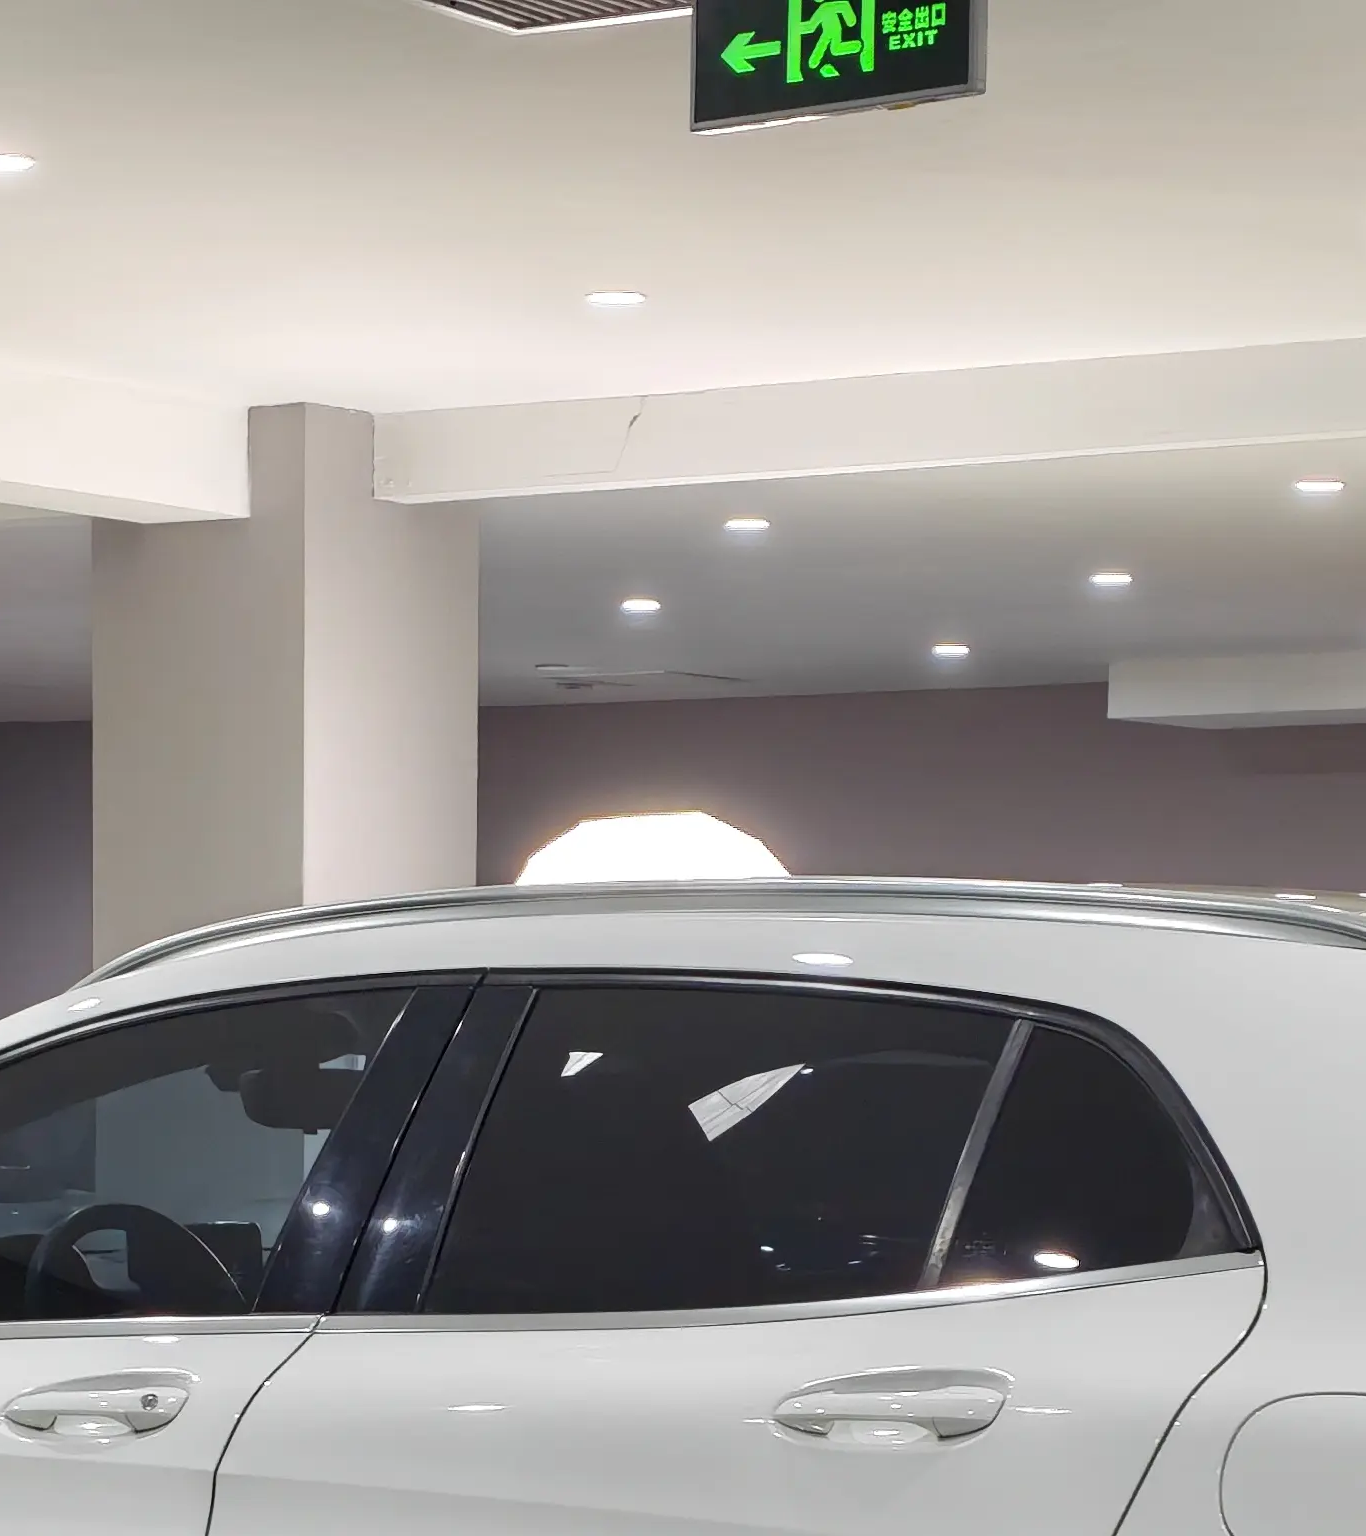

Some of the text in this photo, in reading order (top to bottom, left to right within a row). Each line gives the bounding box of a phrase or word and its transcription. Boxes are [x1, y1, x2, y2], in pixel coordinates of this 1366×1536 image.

[881, 2, 946, 34] 安全出口
[888, 29, 938, 50] EXIT
